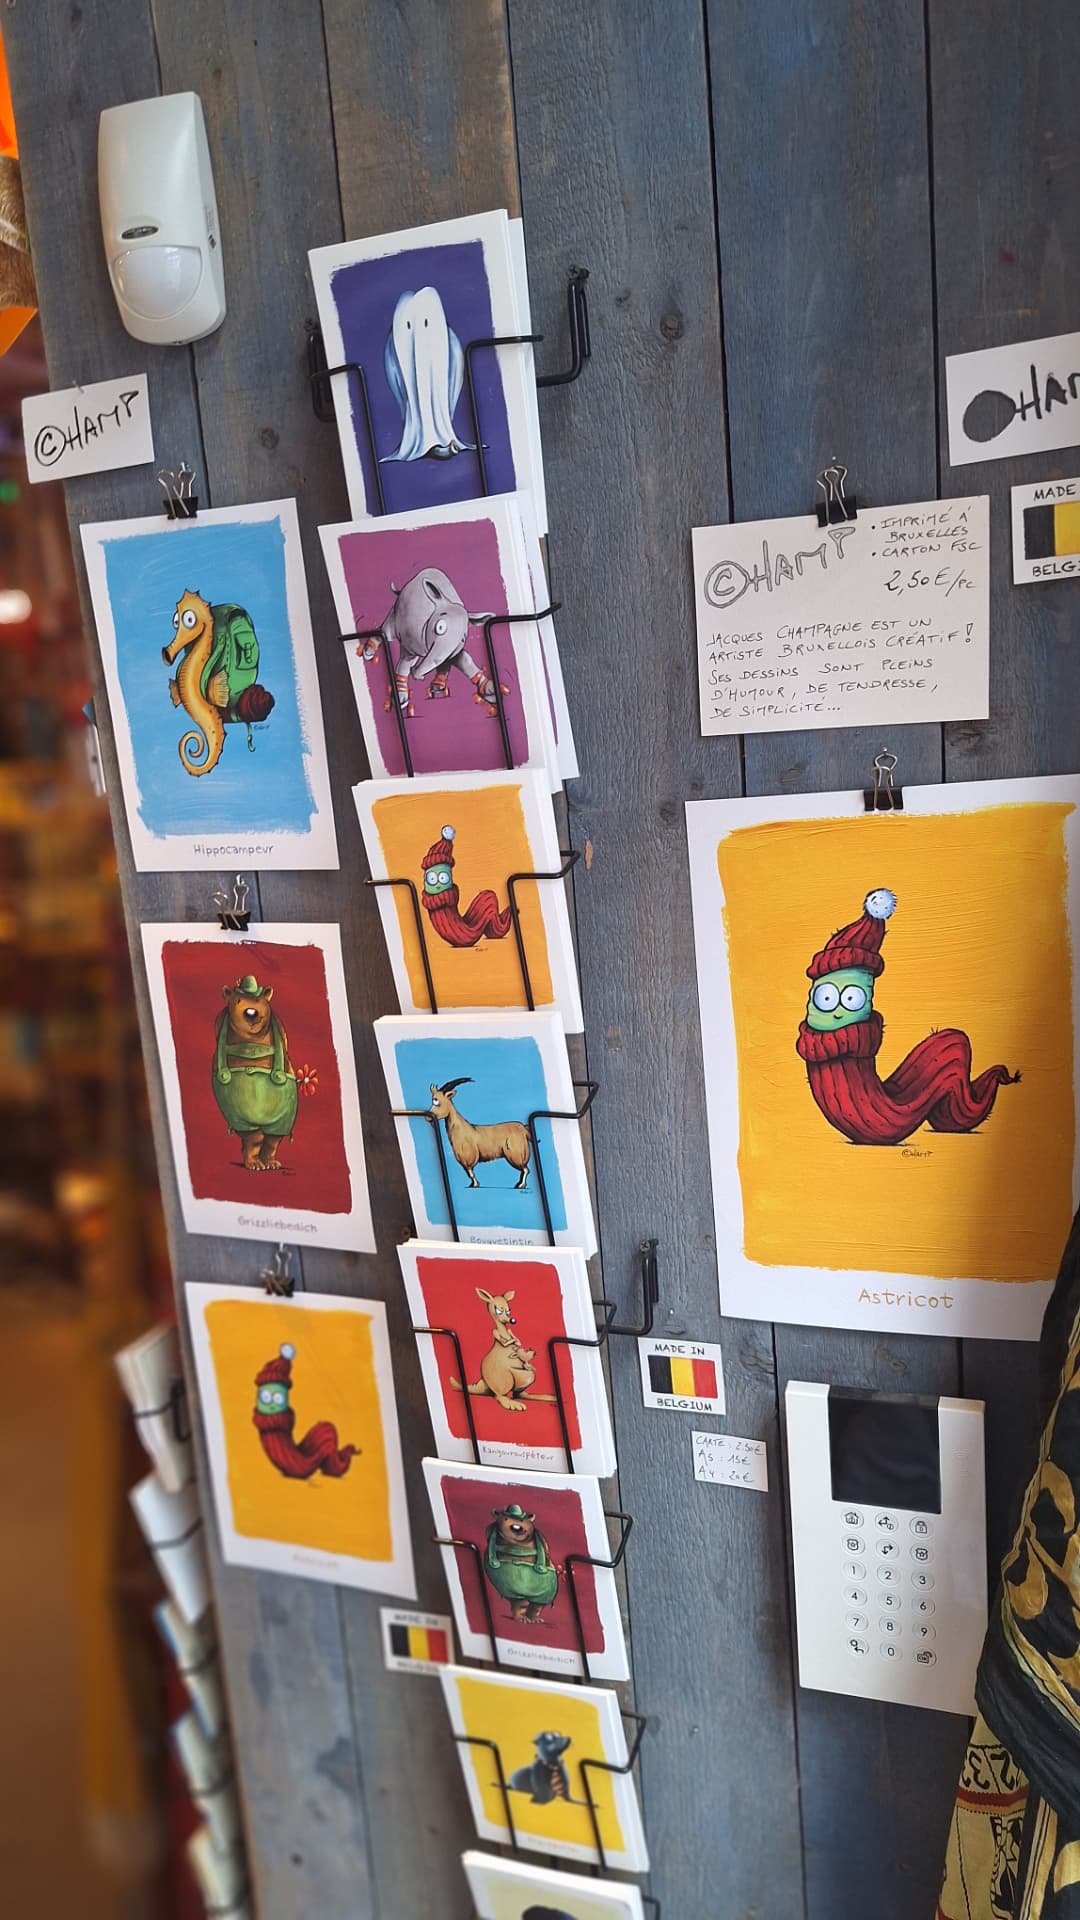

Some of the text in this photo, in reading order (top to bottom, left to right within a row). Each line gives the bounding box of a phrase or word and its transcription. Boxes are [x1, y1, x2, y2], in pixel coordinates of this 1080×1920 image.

[1034, 484, 1076, 501] MADE
[885, 526, 968, 543] BRUXELLES
[882, 538, 983, 557] CARTON FSC
[706, 618, 931, 648] JACQUES CHAMPAGNE EST UN
[818, 662, 864, 673] SONT
[806, 683, 828, 693] DE
[709, 708, 732, 719] DE
[193, 844, 274, 857] Hippocampeur
[858, 1288, 954, 1309] Astricot
[654, 1343, 705, 1356] MADE IN
[656, 1398, 713, 1412] BELGIUM
